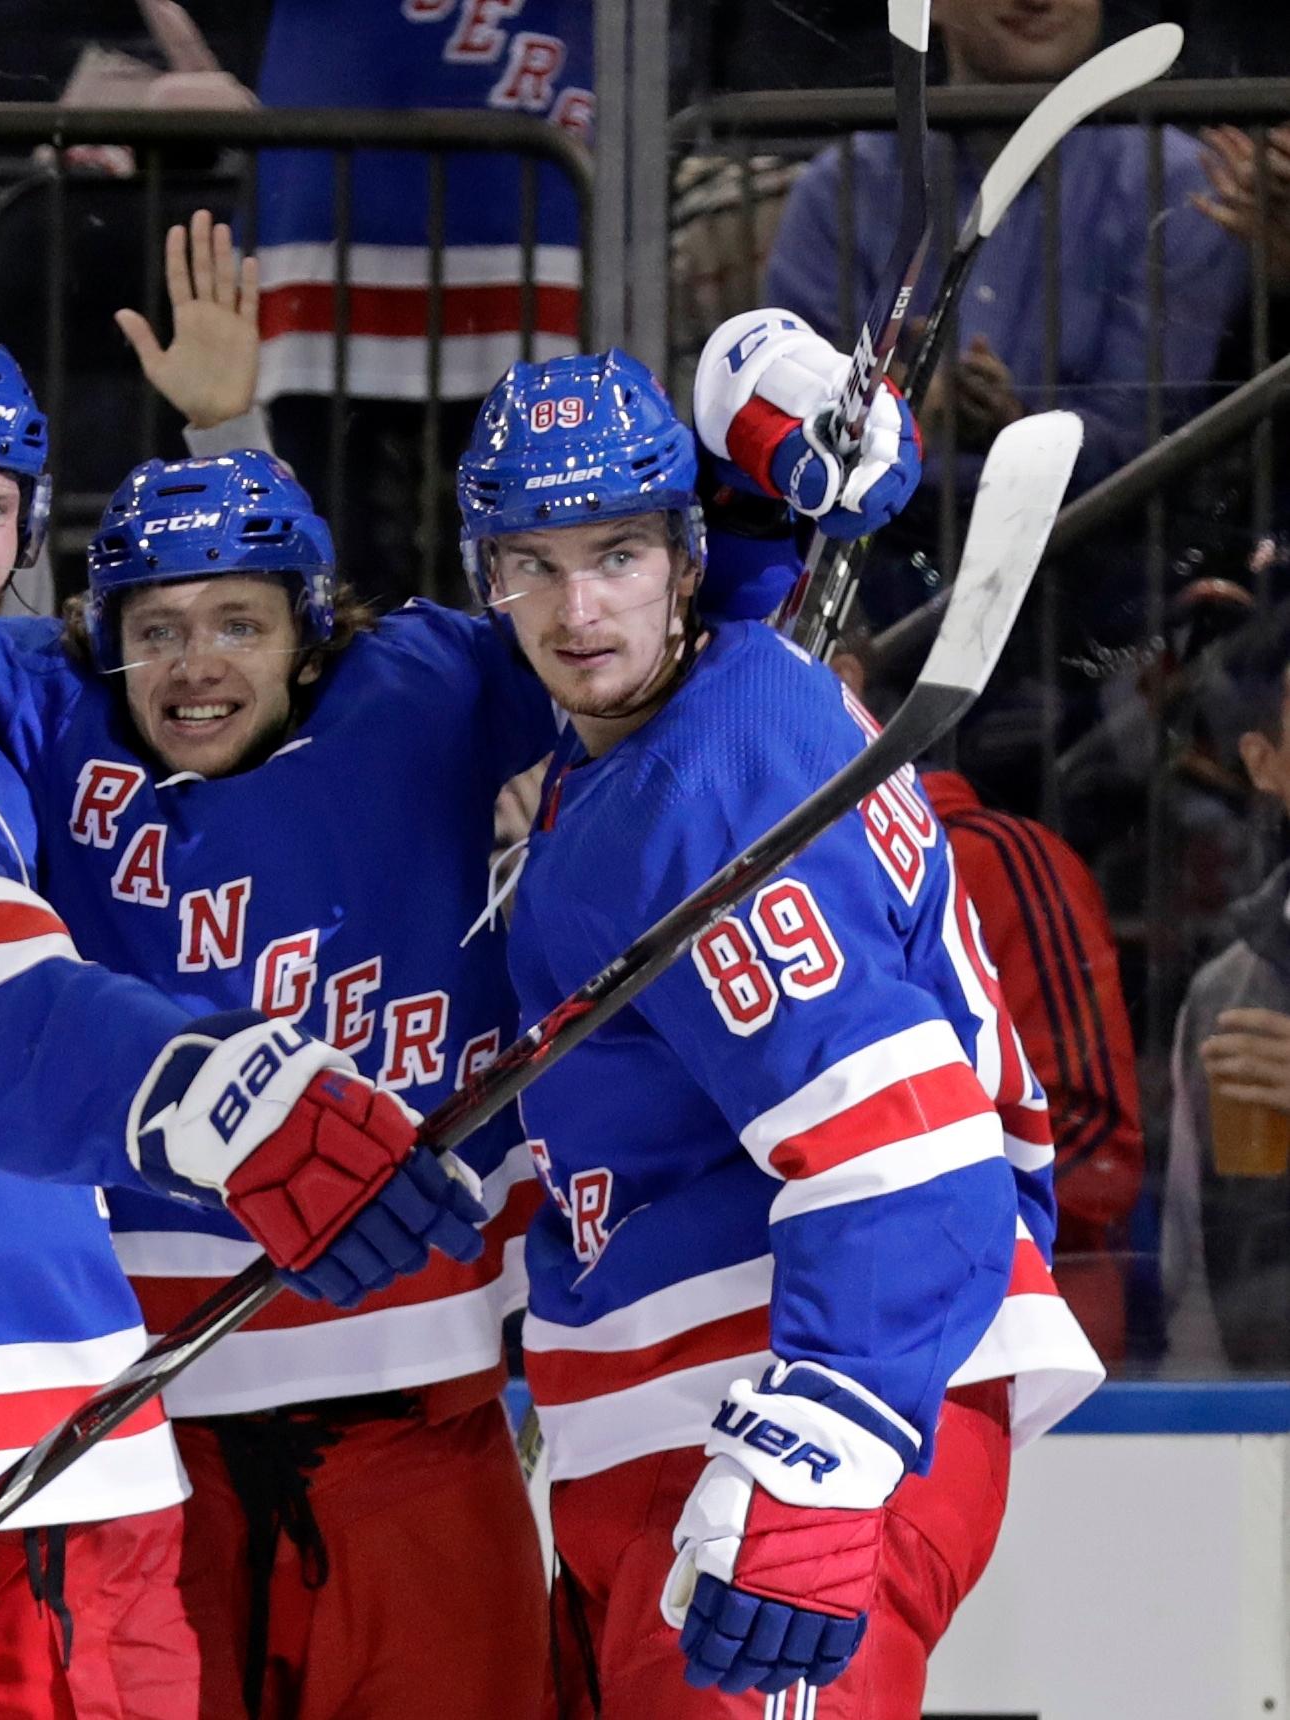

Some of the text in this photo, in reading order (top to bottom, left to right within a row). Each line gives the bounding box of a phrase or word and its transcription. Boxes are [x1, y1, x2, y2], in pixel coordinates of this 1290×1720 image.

[891, 286, 913, 320] CCM
[530, 396, 584, 434] 89
[143, 512, 222, 536] CCM
[690, 876, 846, 1038] 89
